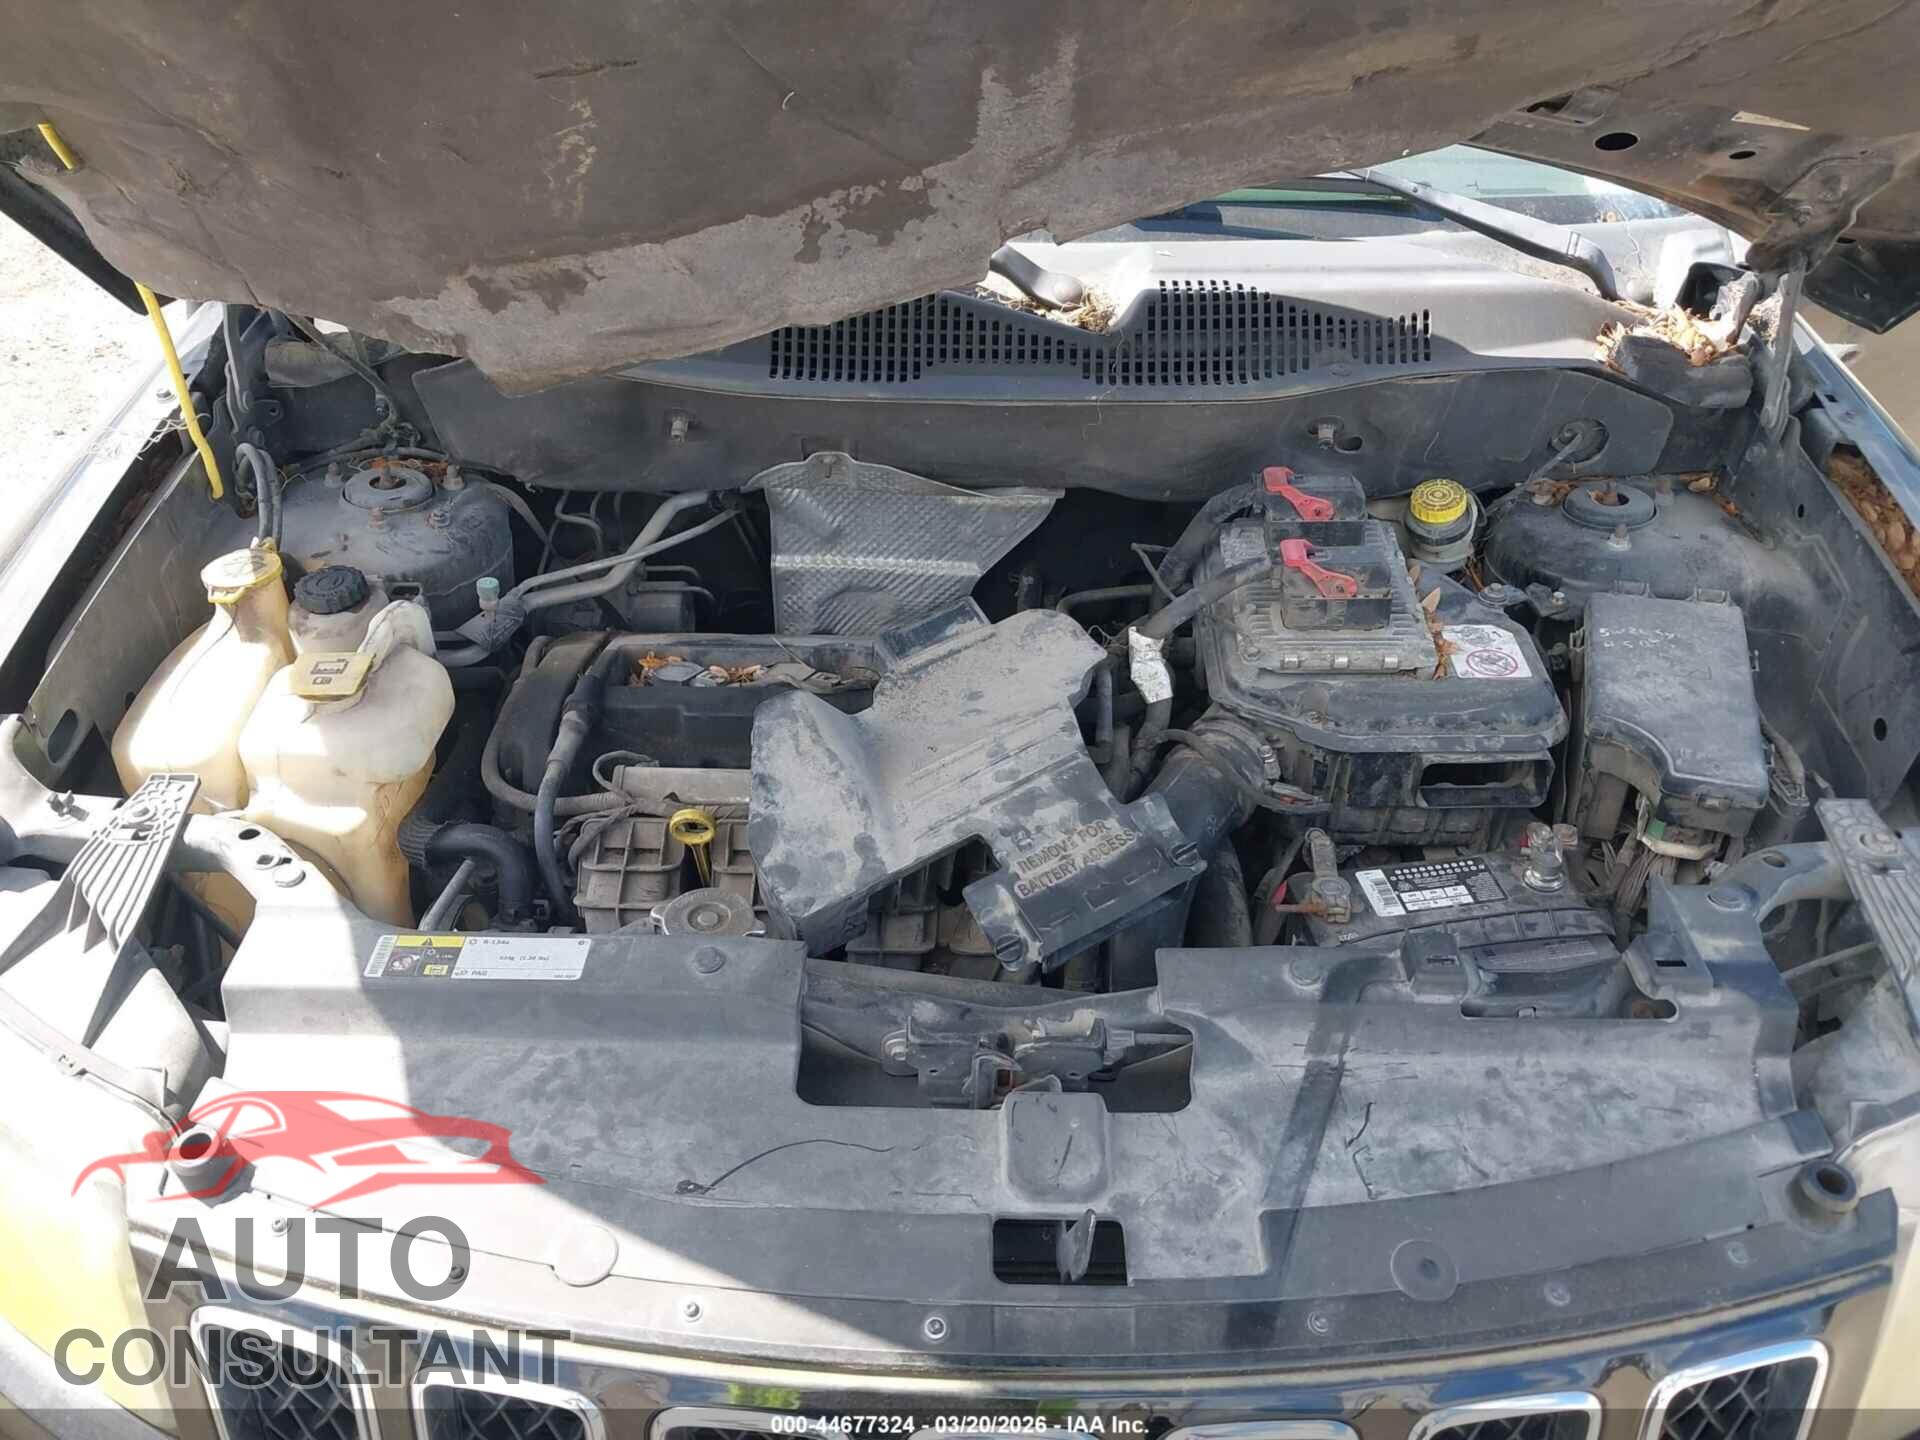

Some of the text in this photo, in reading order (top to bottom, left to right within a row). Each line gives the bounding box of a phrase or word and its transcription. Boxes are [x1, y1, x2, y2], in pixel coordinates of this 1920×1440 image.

[1017, 820, 1111, 873] REMOVE FOR
[1017, 829, 1137, 897] BATTERY ACCESS
